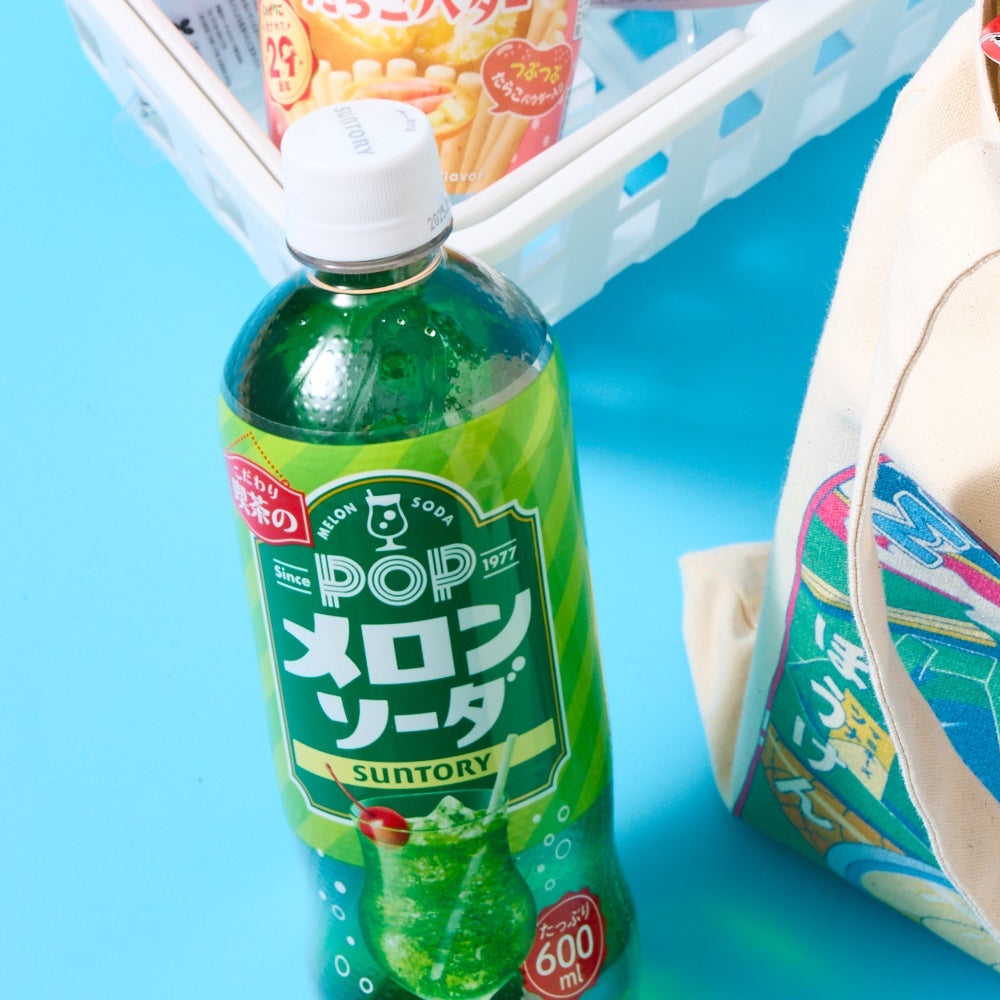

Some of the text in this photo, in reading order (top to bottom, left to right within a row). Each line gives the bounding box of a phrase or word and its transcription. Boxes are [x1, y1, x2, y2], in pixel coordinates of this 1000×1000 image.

[510, 61, 563, 85] つぶつぶ
[333, 105, 375, 157] SUNTORY
[440, 171, 485, 183] lavor
[232, 465, 279, 500] こだわり
[316, 496, 455, 541] MELON SODA
[273, 565, 312, 588] Since
[314, 543, 477, 609] POP
[481, 545, 518, 572] 1977
[283, 587, 533, 690] メロン
[317, 655, 527, 750] ソーダ
[352, 752, 494, 784] SUNTORY
[539, 900, 590, 940] たっぷり
[535, 923, 594, 977] 600
[559, 962, 584, 991] ml
